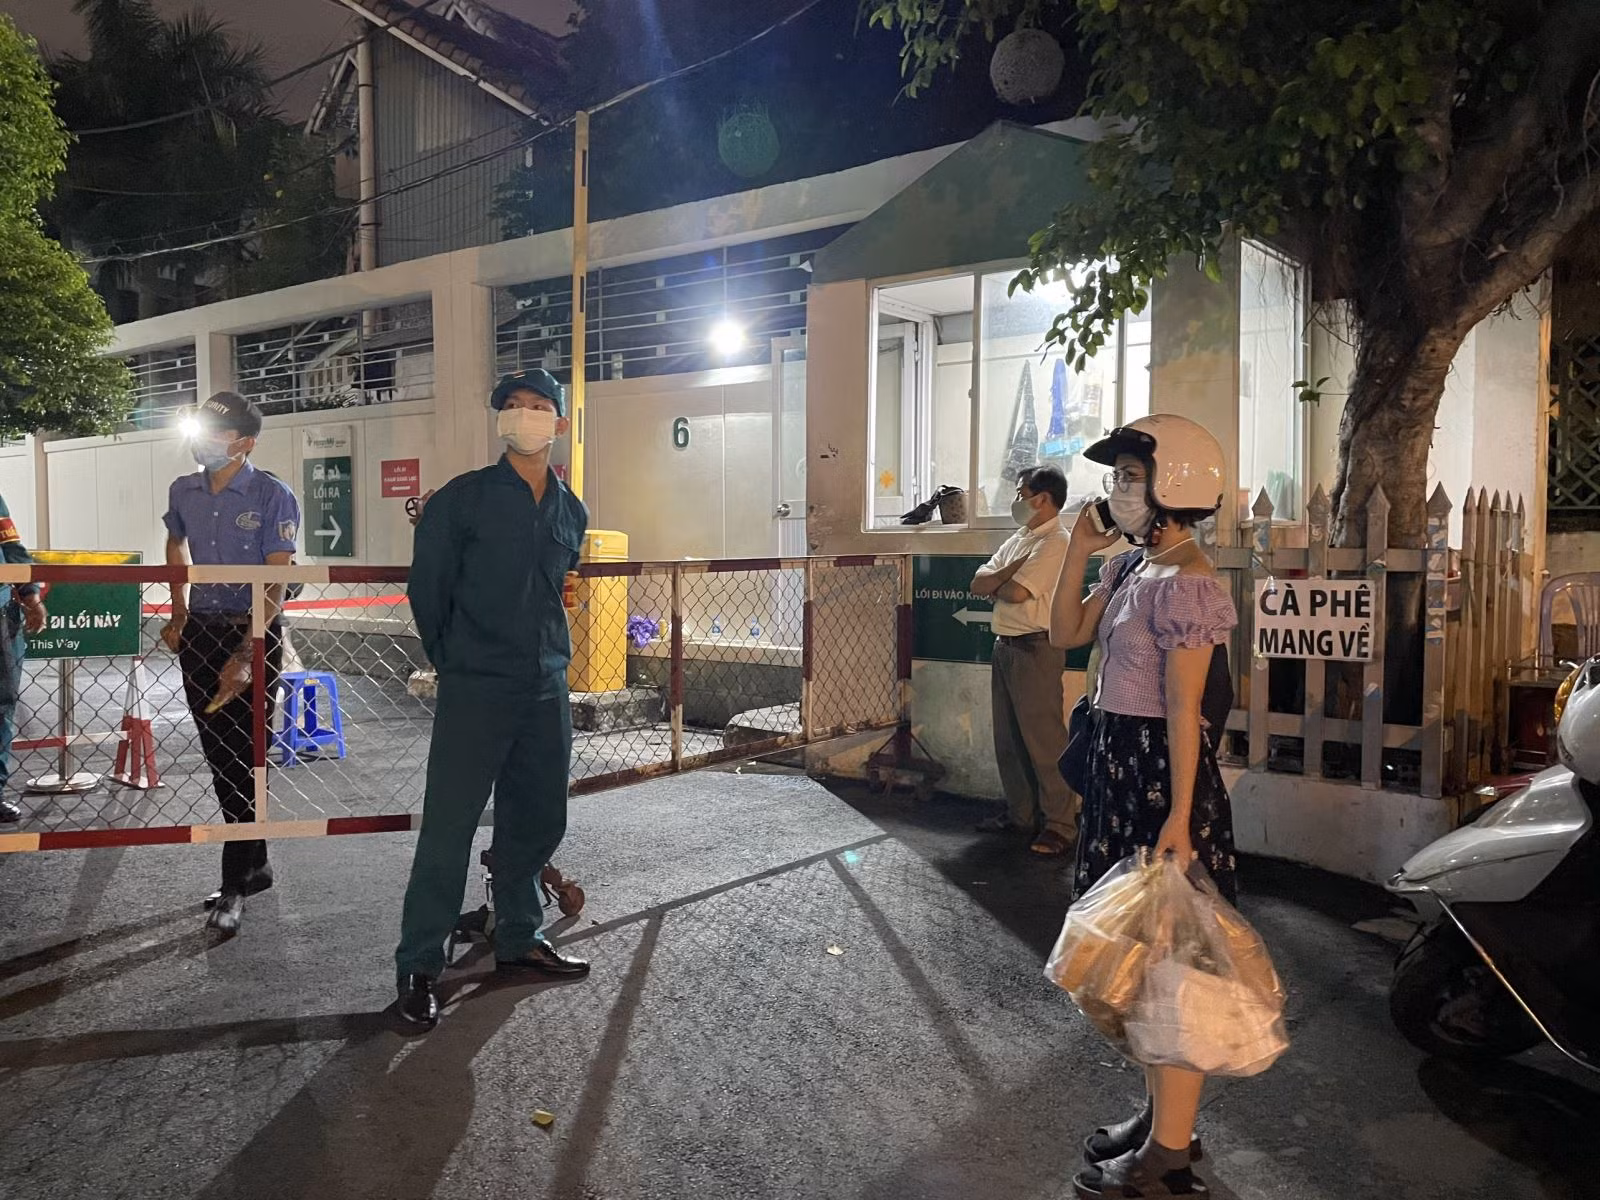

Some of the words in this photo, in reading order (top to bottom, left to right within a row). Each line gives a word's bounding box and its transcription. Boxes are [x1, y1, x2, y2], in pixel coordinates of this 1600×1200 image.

[673, 417, 690, 449] 6
[313, 484, 327, 499] LỐI
[328, 487, 340, 498] RA
[915, 587, 930, 599] LỐI
[943, 588, 965, 599] VÀO
[1259, 583, 1300, 616] CÀ
[1310, 584, 1371, 618] PHÊ
[69, 610, 91, 629] LỐI
[94, 611, 122, 628] NÀY
[30, 639, 54, 649] This
[56, 639, 80, 650] Way
[1259, 628, 1333, 656] MANG
[1338, 623, 1370, 658] VỀ
